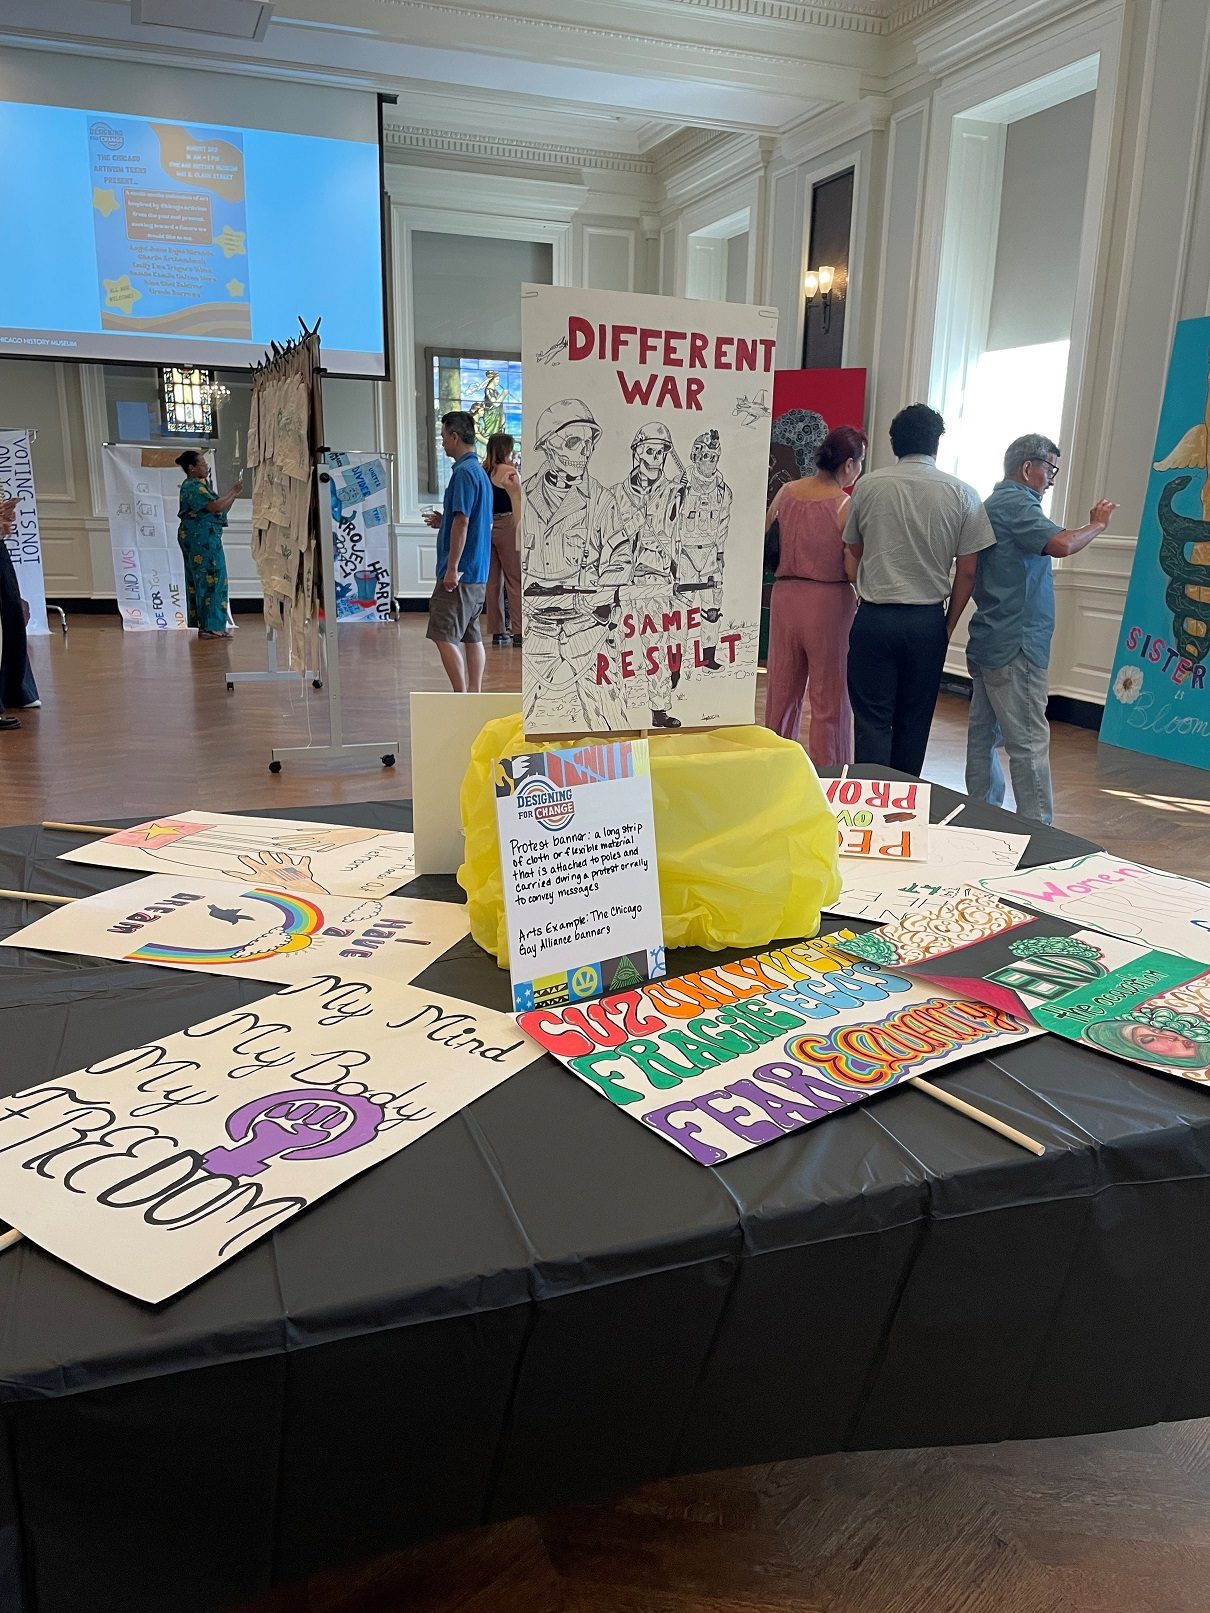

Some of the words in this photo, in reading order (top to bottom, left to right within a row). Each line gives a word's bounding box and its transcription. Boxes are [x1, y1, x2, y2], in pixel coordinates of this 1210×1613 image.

[568, 316, 776, 373] DIFFERENT
[616, 370, 705, 411] WAR
[13, 437, 34, 501] VOTING
[20, 508, 36, 529] IS
[21, 533, 41, 564] NOT
[338, 514, 364, 579] PROJECT
[124, 574, 140, 600] LAND
[169, 583, 181, 607] ME
[368, 560, 390, 599] HEAR
[152, 591, 163, 610] FOR
[376, 603, 391, 621] US
[623, 606, 701, 639] SAME
[595, 633, 742, 686] RESULT
[1126, 626, 1207, 689] SISTER
[517, 789, 573, 809] DESIGNING
[518, 810, 533, 820] FOR
[534, 802, 575, 819] CHANGE
[509, 839, 549, 855] Protest
[594, 831, 601, 839] a
[603, 827, 620, 840] long
[622, 823, 643, 834] strip
[513, 856, 523, 867] of
[526, 850, 549, 865] cloth
[553, 852, 563, 860] or
[564, 844, 598, 857] flexible
[600, 836, 634, 850] material
[512, 868, 534, 880] that
[538, 865, 548, 876] is
[550, 860, 587, 874] attached
[590, 855, 599, 865] to
[601, 852, 621, 866] poles
[624, 847, 639, 857] and
[515, 877, 552, 893] carried
[555, 873, 582, 885] during
[591, 864, 619, 881] protest
[630, 858, 648, 872] rally
[515, 895, 526, 905] to
[528, 892, 554, 905] convey
[558, 882, 600, 898] messages
[1008, 866, 1150, 903] Women
[519, 927, 543, 943] Arts
[545, 914, 589, 934] Example:
[590, 909, 608, 922] The
[610, 904, 643, 919] Chicago
[394, 938, 432, 947] I
[519, 943, 537, 958] Gay
[540, 936, 572, 952] Alliance
[574, 925, 611, 941] banners
[983, 953, 1108, 1002] END
[276, 975, 374, 1026] My
[386, 1004, 525, 1062] Mind
[516, 990, 667, 1057] CUZ
[643, 957, 789, 1019] ONLY
[1039, 1003, 1106, 1024] the
[85, 1045, 219, 1117] My
[185, 1013, 296, 1079] My
[290, 1049, 437, 1132] Body
[642, 1060, 868, 1166] FEAR
